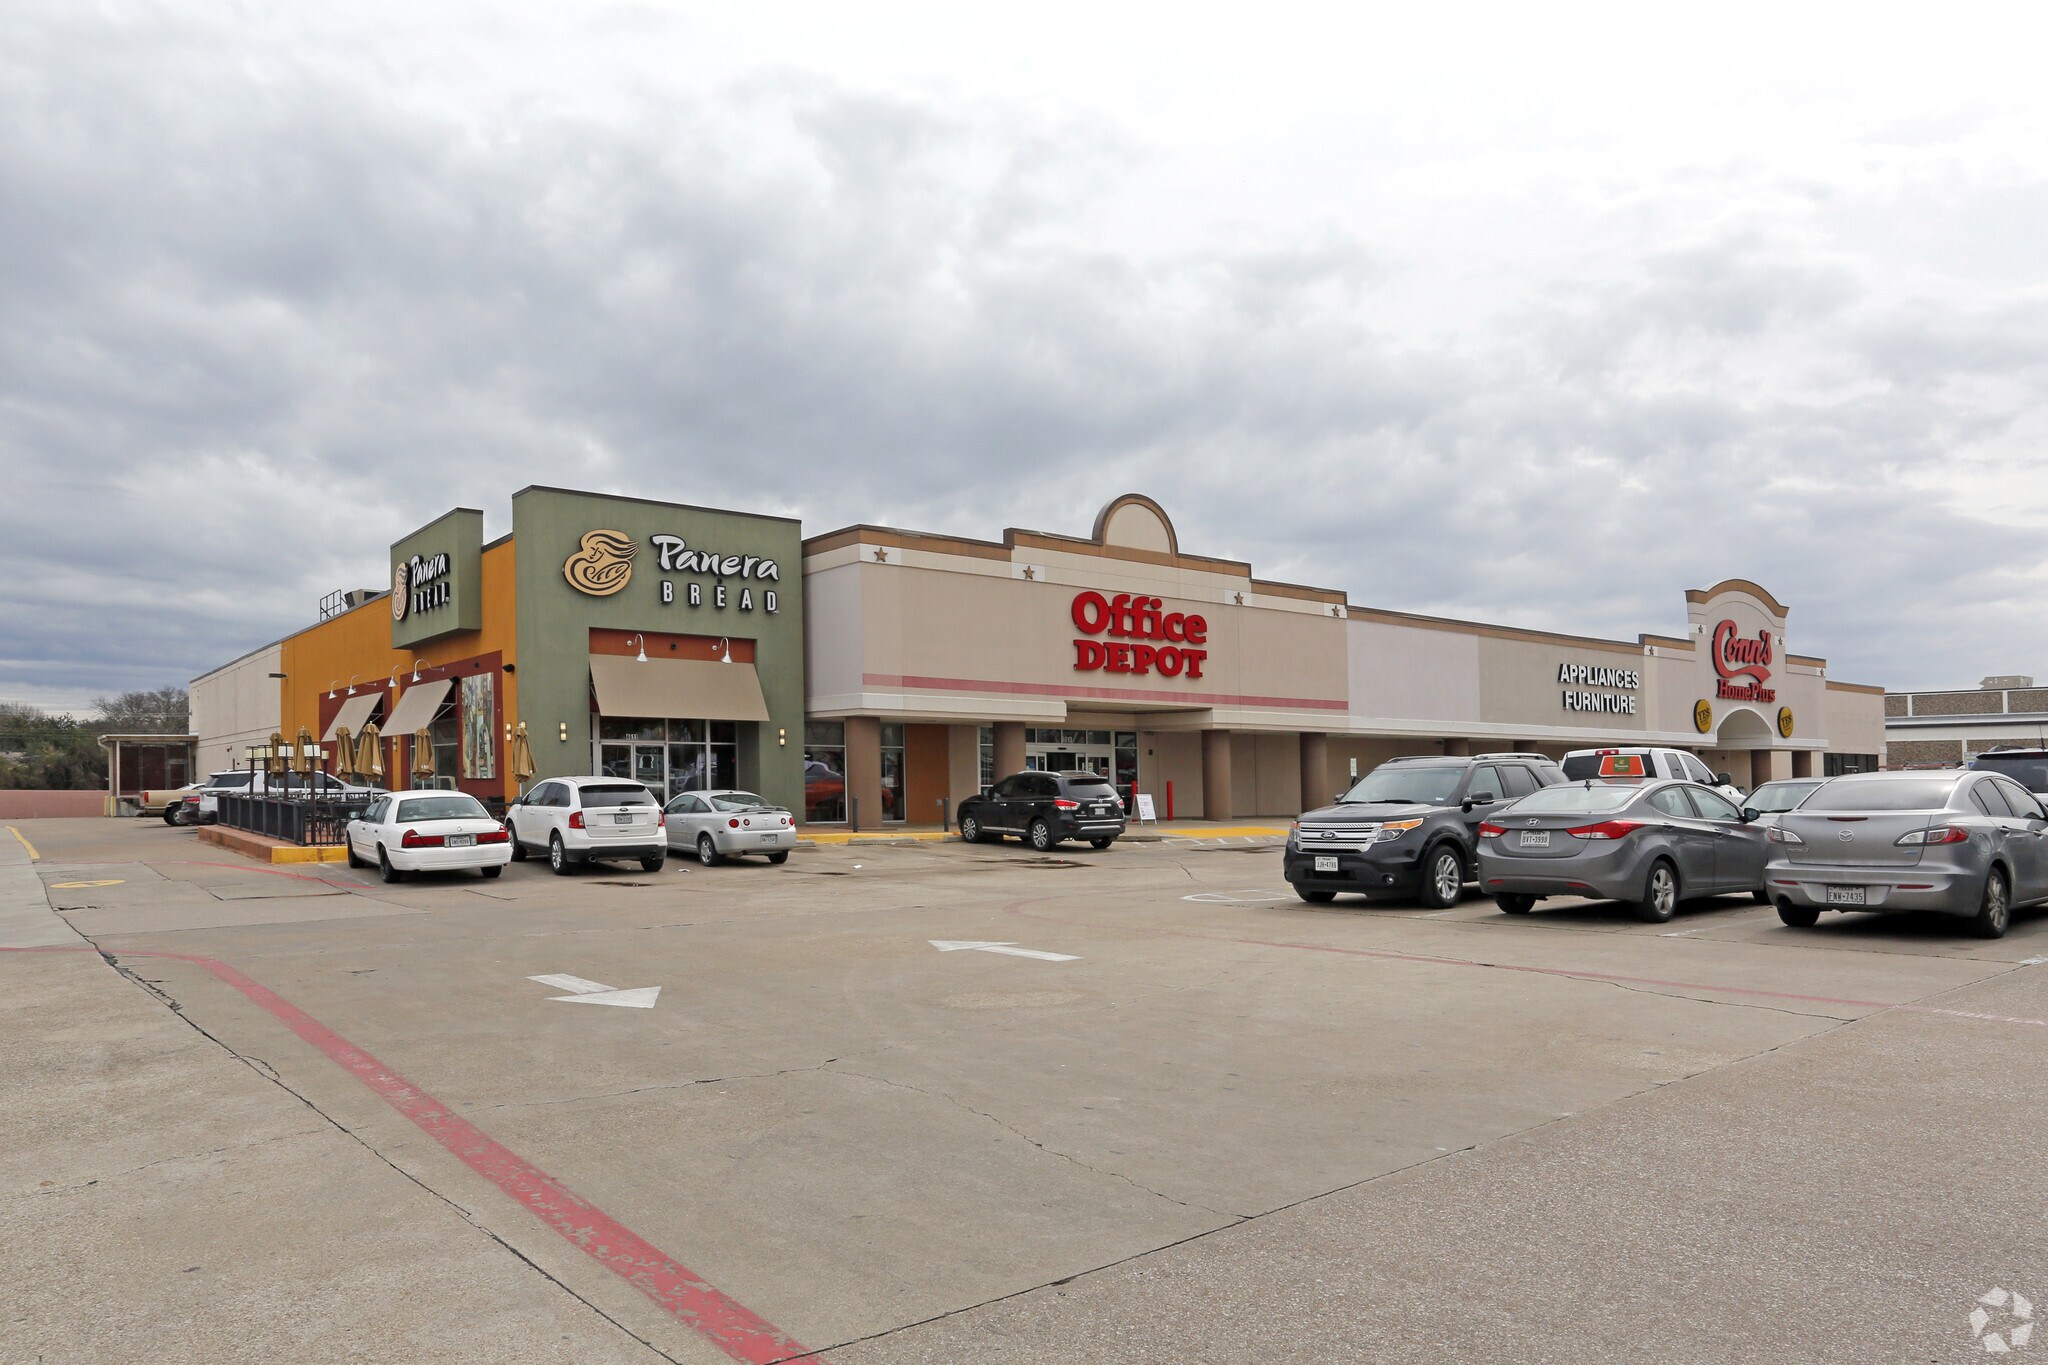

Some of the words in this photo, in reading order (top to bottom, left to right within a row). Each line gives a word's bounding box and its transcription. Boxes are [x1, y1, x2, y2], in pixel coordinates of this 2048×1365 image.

[411, 553, 450, 588] Panera
[650, 534, 779, 581] Panera
[661, 580, 778, 612] BREAD
[1071, 591, 1207, 644] Office
[1073, 639, 1207, 677] DEPOT
[1712, 619, 1772, 683] Conn's
[1558, 663, 1639, 689] APPLIANCES
[1563, 691, 1636, 714] FURNITURE
